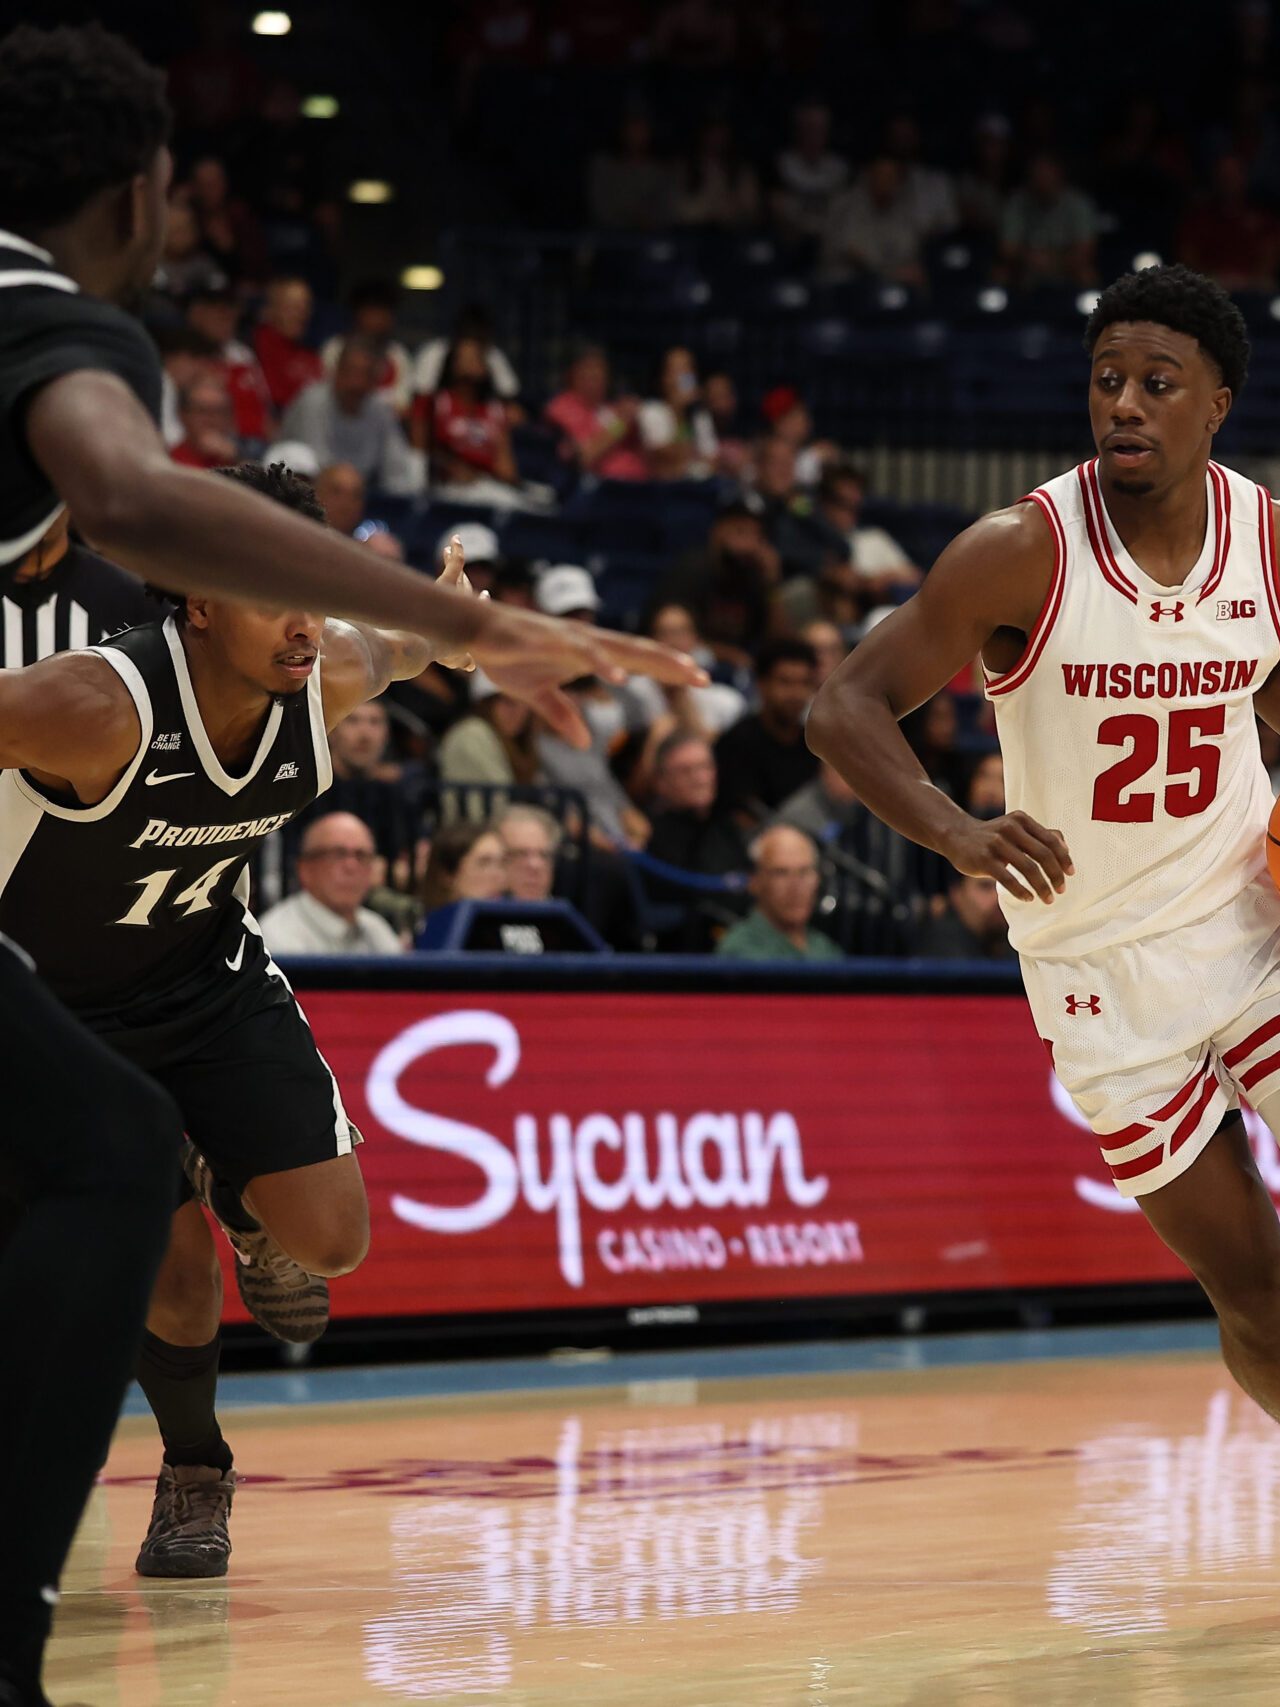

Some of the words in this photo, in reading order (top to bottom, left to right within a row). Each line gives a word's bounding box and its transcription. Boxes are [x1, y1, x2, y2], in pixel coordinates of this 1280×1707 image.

[1061, 659, 1258, 699] WISCONSIN
[151, 740, 181, 750] CHANGE
[157, 733, 170, 742] BE
[170, 732, 182, 742] THE
[274, 767, 300, 780] EAST
[1091, 703, 1226, 823] 25
[128, 811, 294, 849] PROVIDENCE
[113, 855, 240, 926] 14
[366, 1009, 829, 1288] Sycuan
[597, 1224, 727, 1273] CASINO
